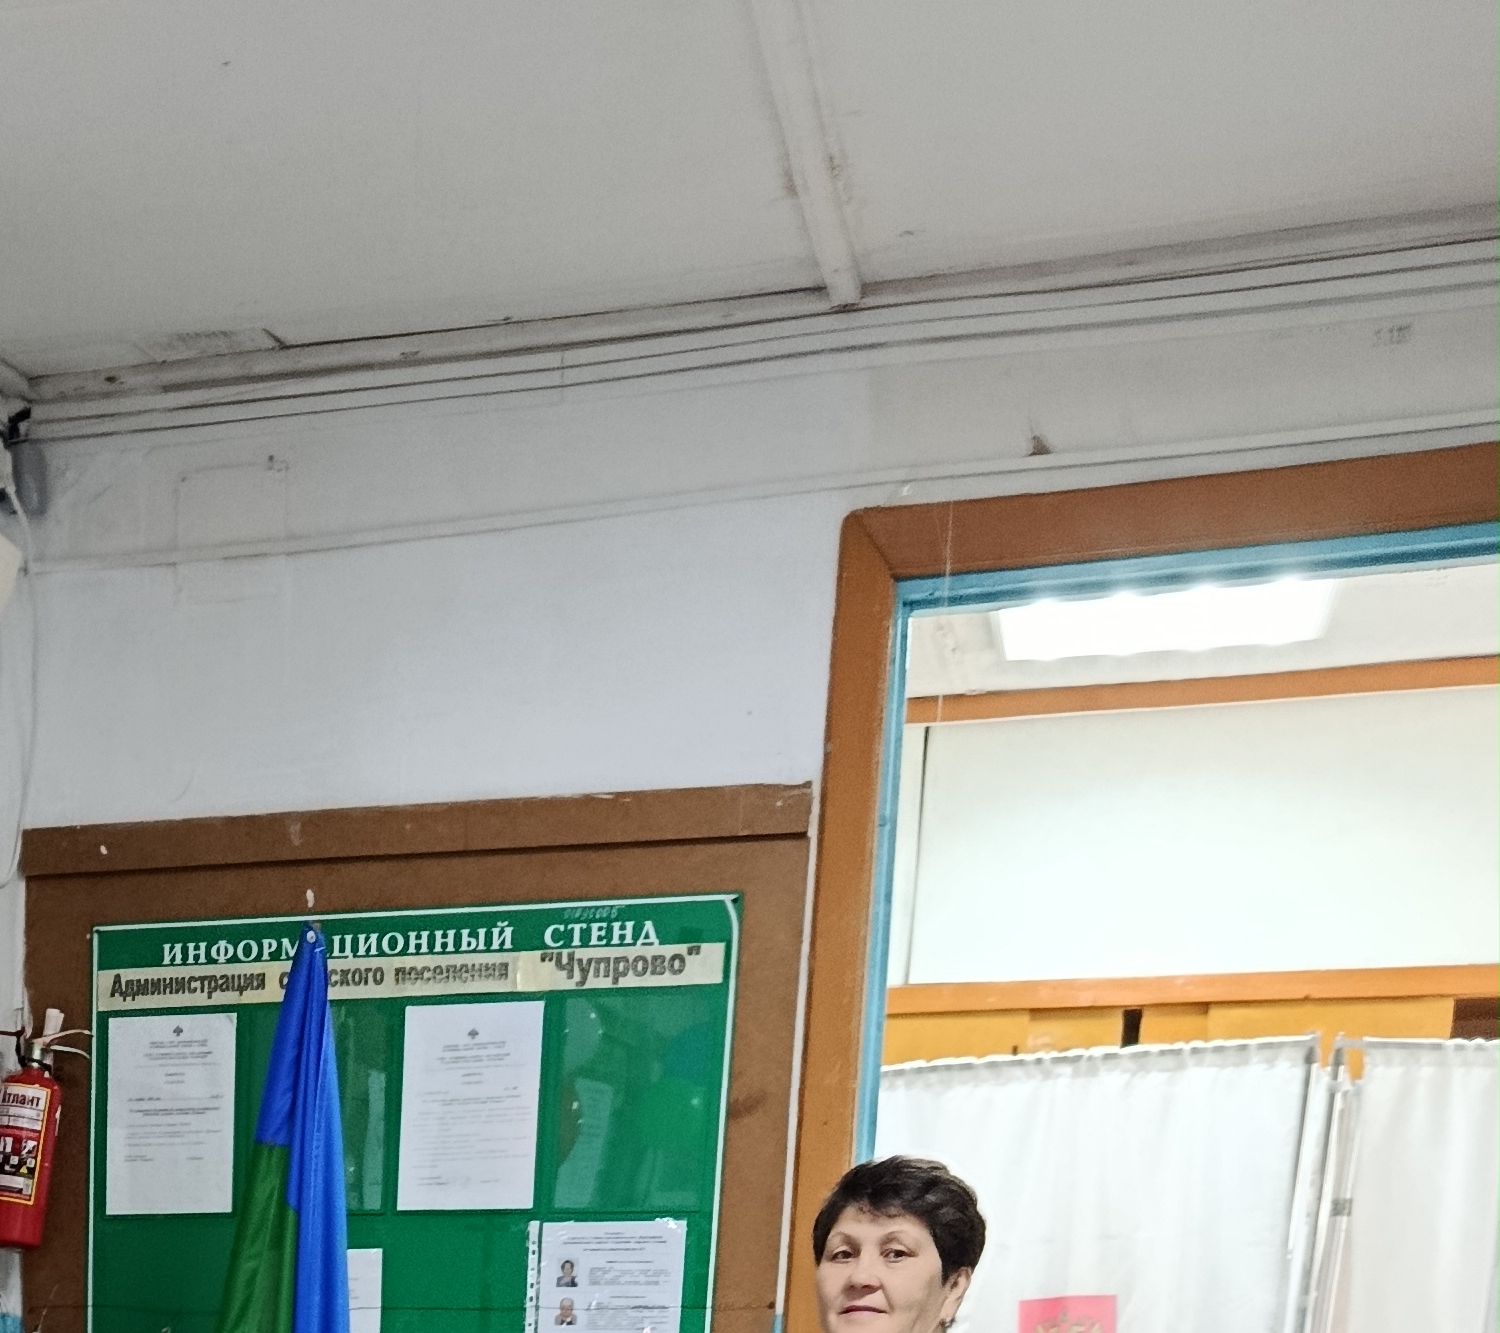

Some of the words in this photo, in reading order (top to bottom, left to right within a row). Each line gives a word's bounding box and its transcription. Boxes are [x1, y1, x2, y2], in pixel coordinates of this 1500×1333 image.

[161, 921, 514, 966] ИНФОРМЦИОННЫЙ
[544, 919, 660, 948] СТЕНД
[109, 971, 267, 1003] Администрация
[278, 965, 385, 990] сского
[394, 960, 510, 987] поселения
[540, 945, 702, 988] "Чупрово"
